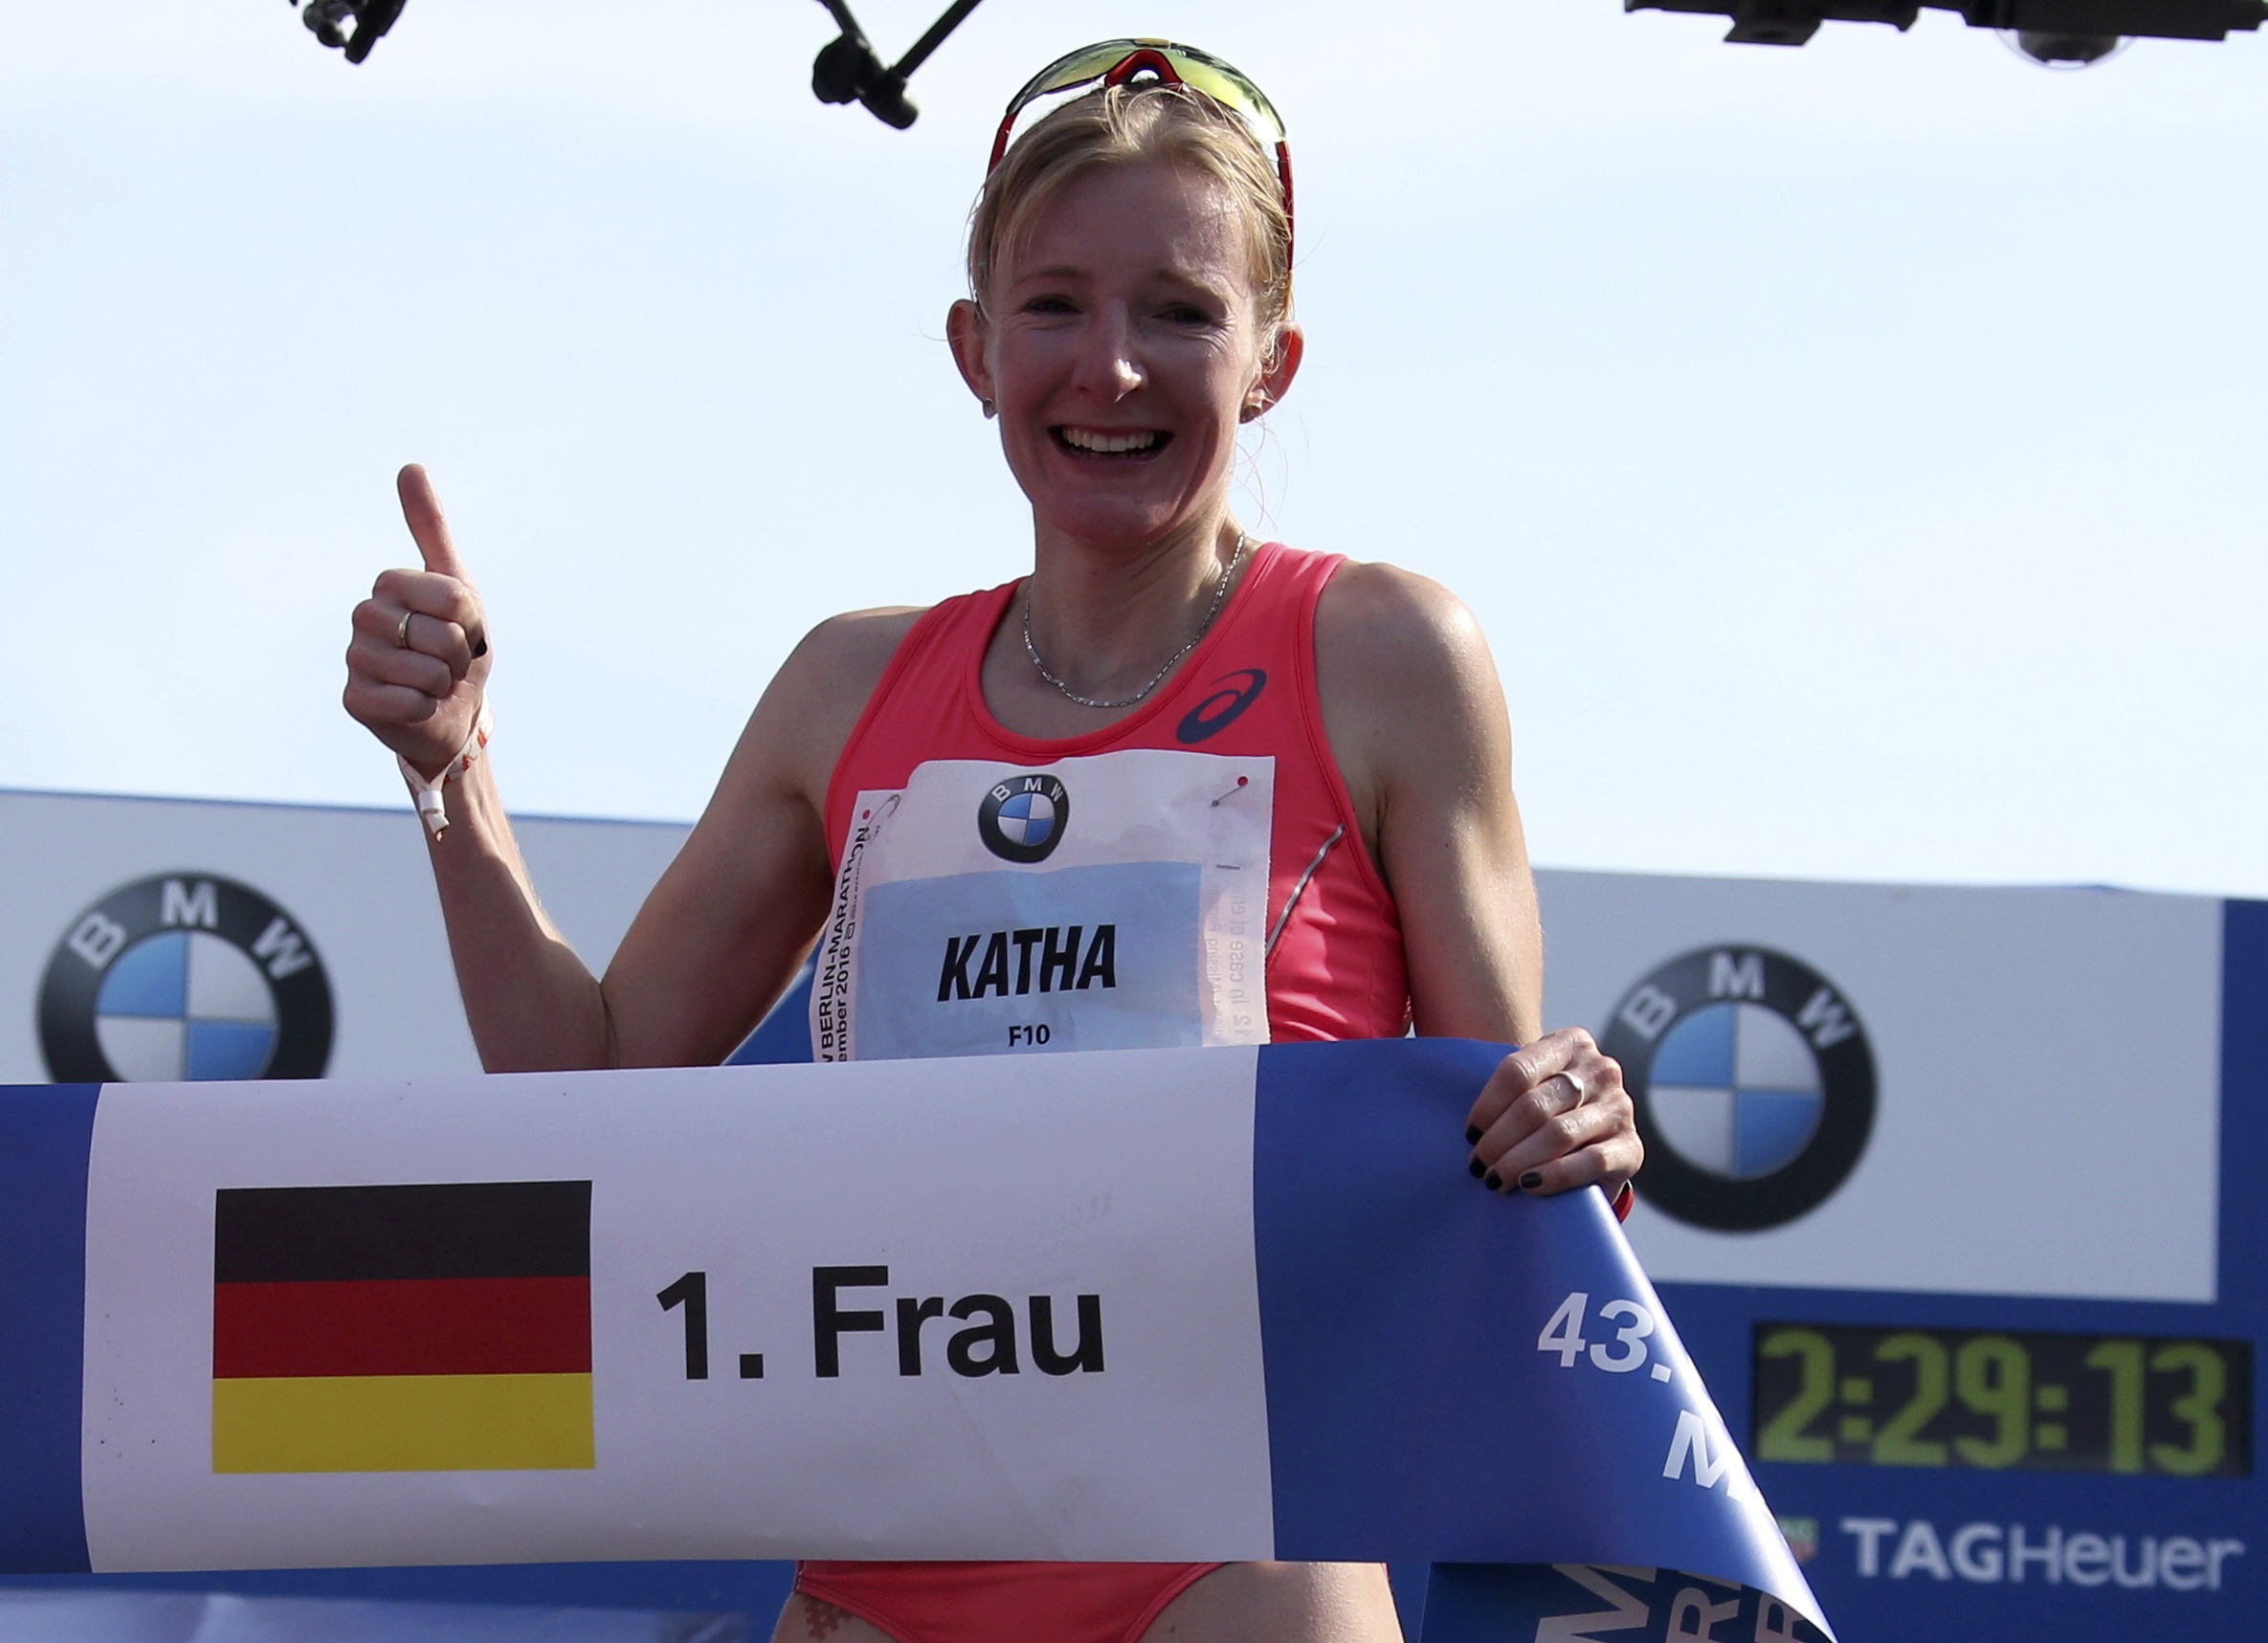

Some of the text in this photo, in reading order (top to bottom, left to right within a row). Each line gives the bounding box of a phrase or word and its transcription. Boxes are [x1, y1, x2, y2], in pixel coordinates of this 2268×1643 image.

[991, 777, 1063, 802] BMW
[69, 878, 312, 980] BMW
[819, 827, 869, 1049] BERLIN-MARATHON
[835, 945, 851, 995] 2016
[937, 924, 1116, 1002] KATHA
[1009, 1024, 1051, 1047] F10
[1621, 952, 1857, 1050] BMW
[656, 1265, 1104, 1379] 1. Frau
[1537, 1292, 1672, 1383] 43.
[1757, 1328, 2226, 1476] 2:29:13
